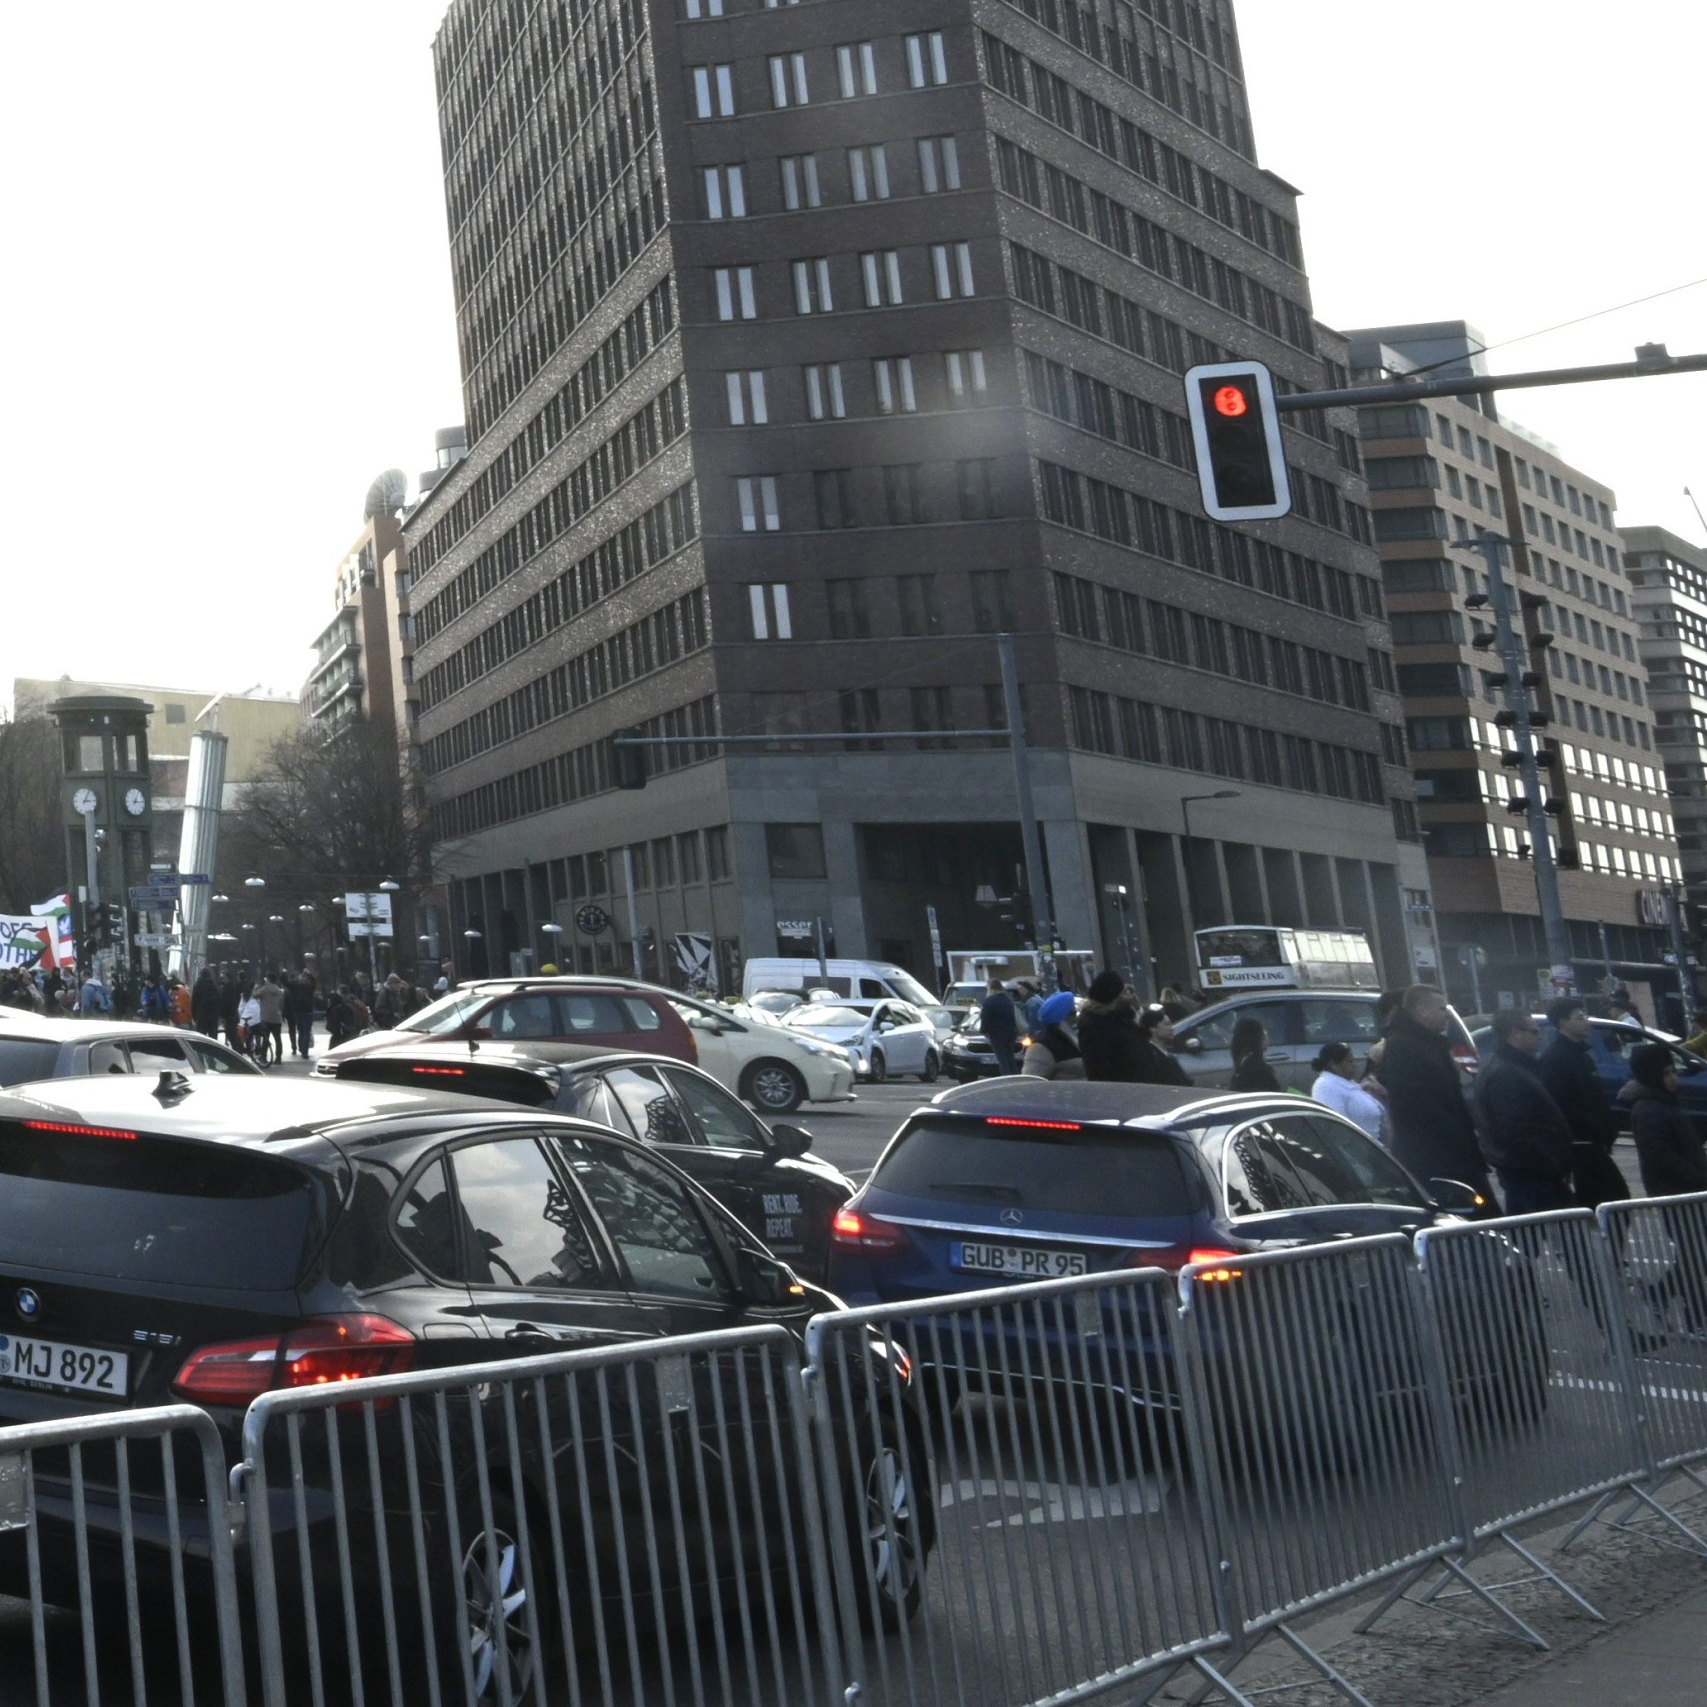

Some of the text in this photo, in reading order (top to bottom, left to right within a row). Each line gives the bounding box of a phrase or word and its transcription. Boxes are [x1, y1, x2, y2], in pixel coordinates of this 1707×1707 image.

[1223, 972, 1285, 981] SIGHTSEEING
[762, 1194, 784, 1214] RENT.
[961, 1245, 1085, 1276] GUB PR 95
[14, 1341, 52, 1378] MJ
[60, 1349, 114, 1389] 892
